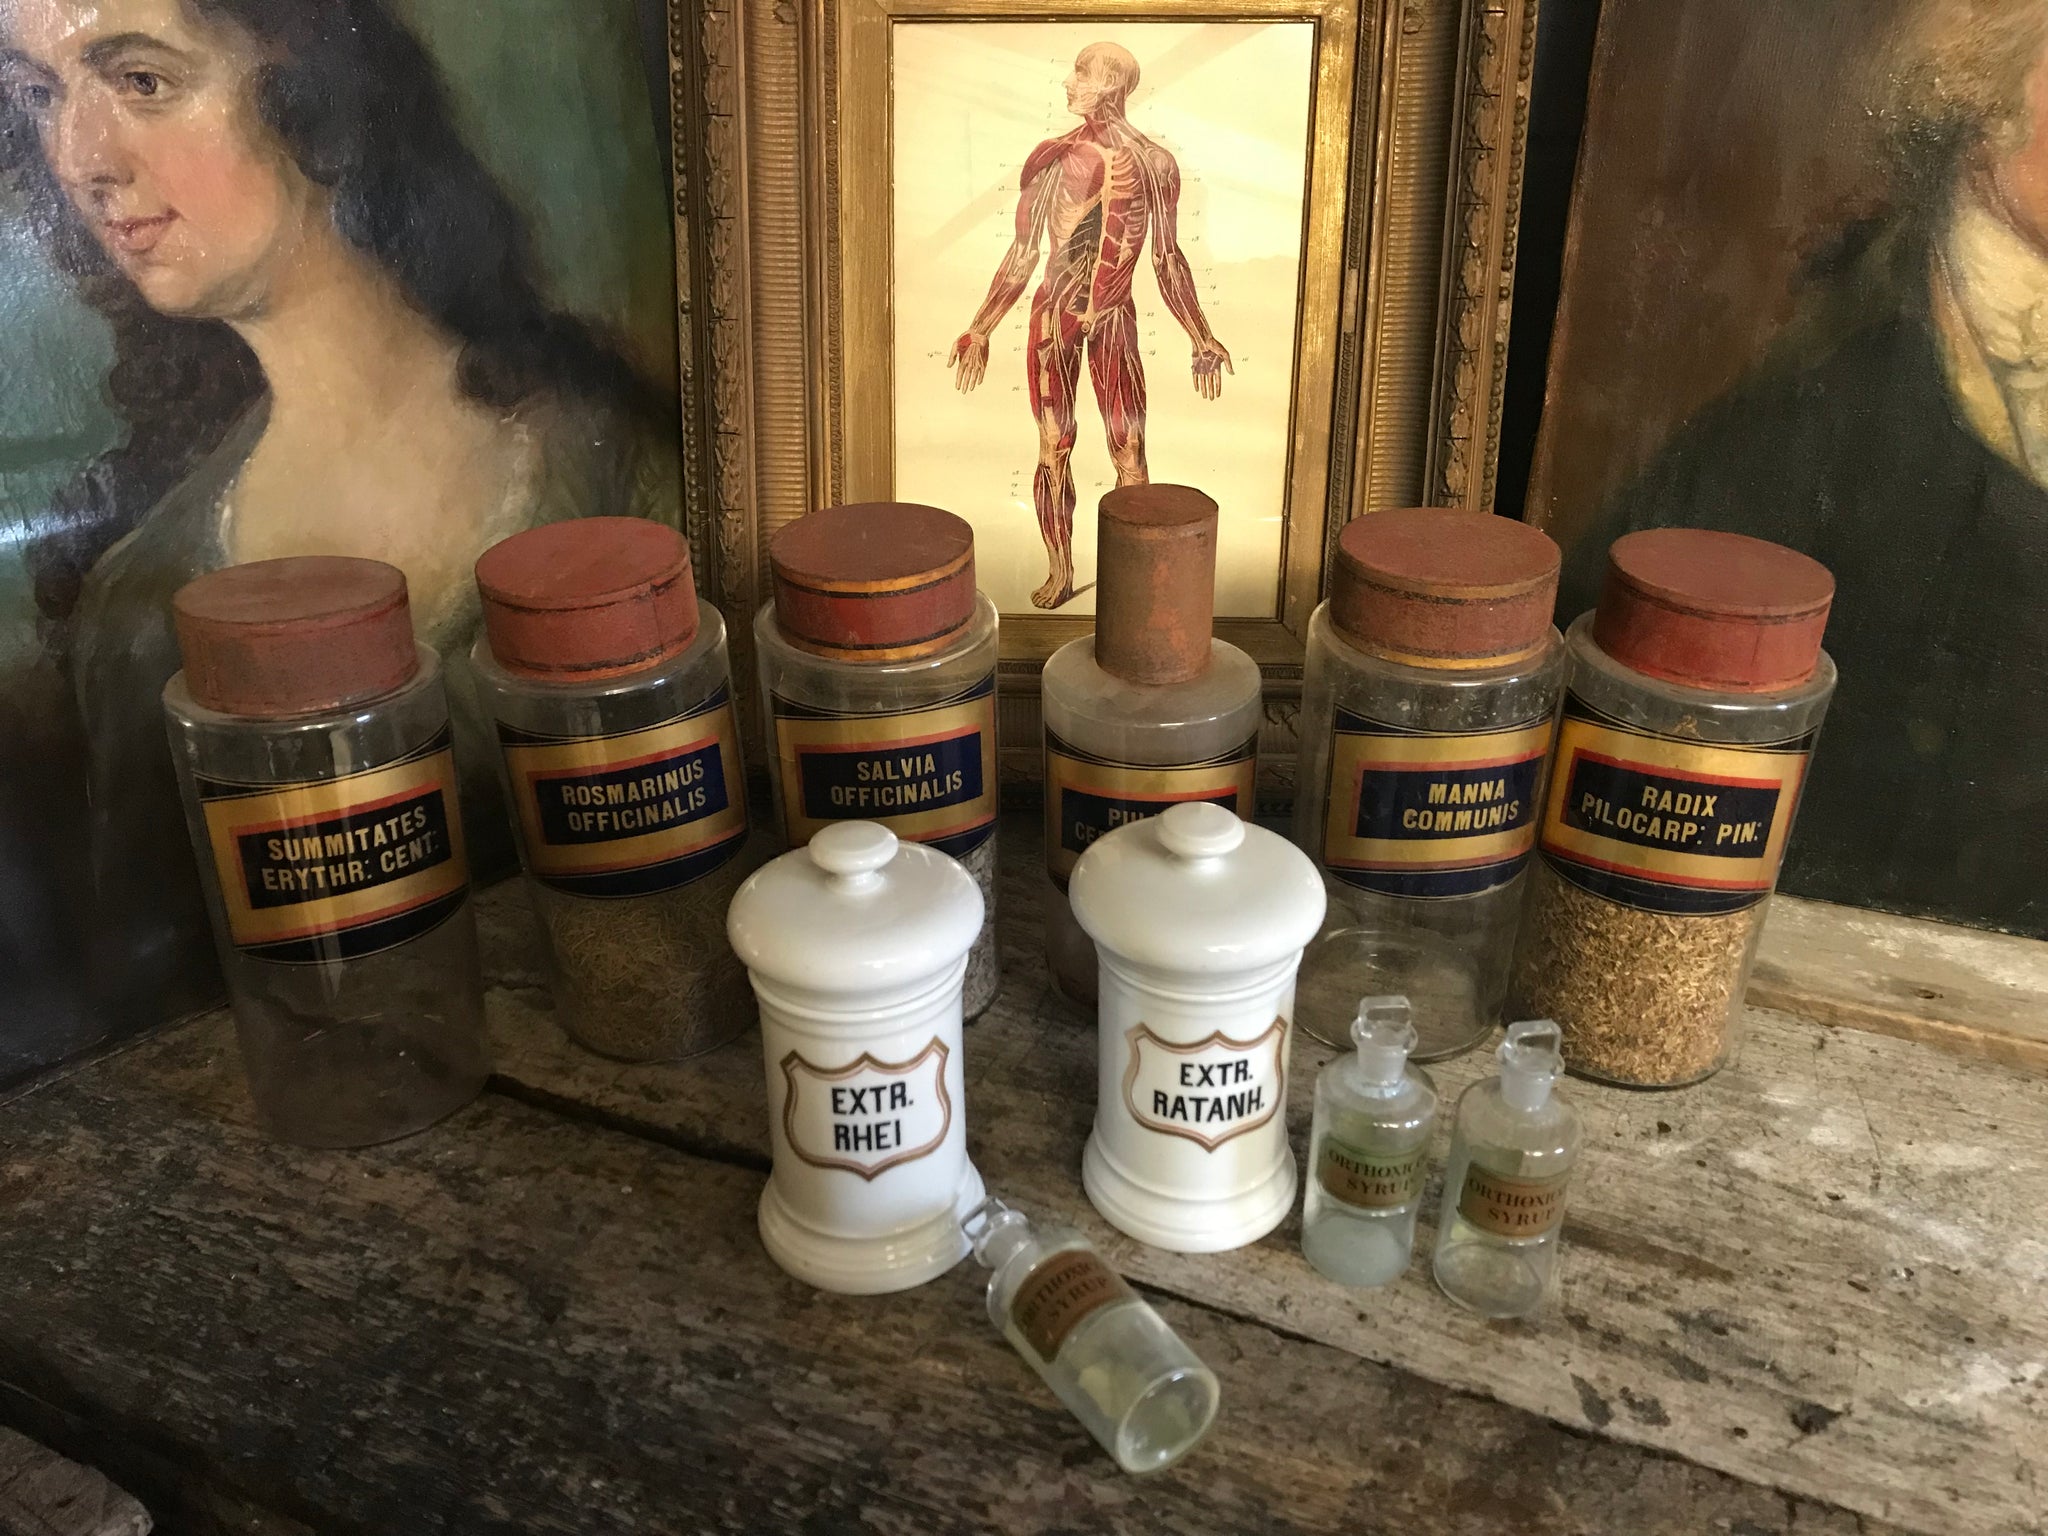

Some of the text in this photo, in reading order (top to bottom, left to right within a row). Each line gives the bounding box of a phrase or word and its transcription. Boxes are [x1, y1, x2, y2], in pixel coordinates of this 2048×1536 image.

[561, 758, 704, 806] ROSMARINUS
[857, 753, 936, 781] SALVIA
[830, 770, 963, 807] OFFICINALIS
[1428, 778, 1505, 804] MANNA
[1641, 785, 1718, 817] RADIX
[567, 786, 706, 833] OFFICINALIS
[1402, 800, 1519, 832] COMMUNIS
[1581, 792, 1706, 845] PILOCARP:
[267, 805, 427, 862] SUMMITATES
[262, 858, 373, 891] ERYTHR:
[1180, 1059, 1254, 1088] EXTR.
[831, 1081, 914, 1116] EXTR.
[1152, 1086, 1264, 1123] RATANH.
[834, 1120, 902, 1152] RHEI
